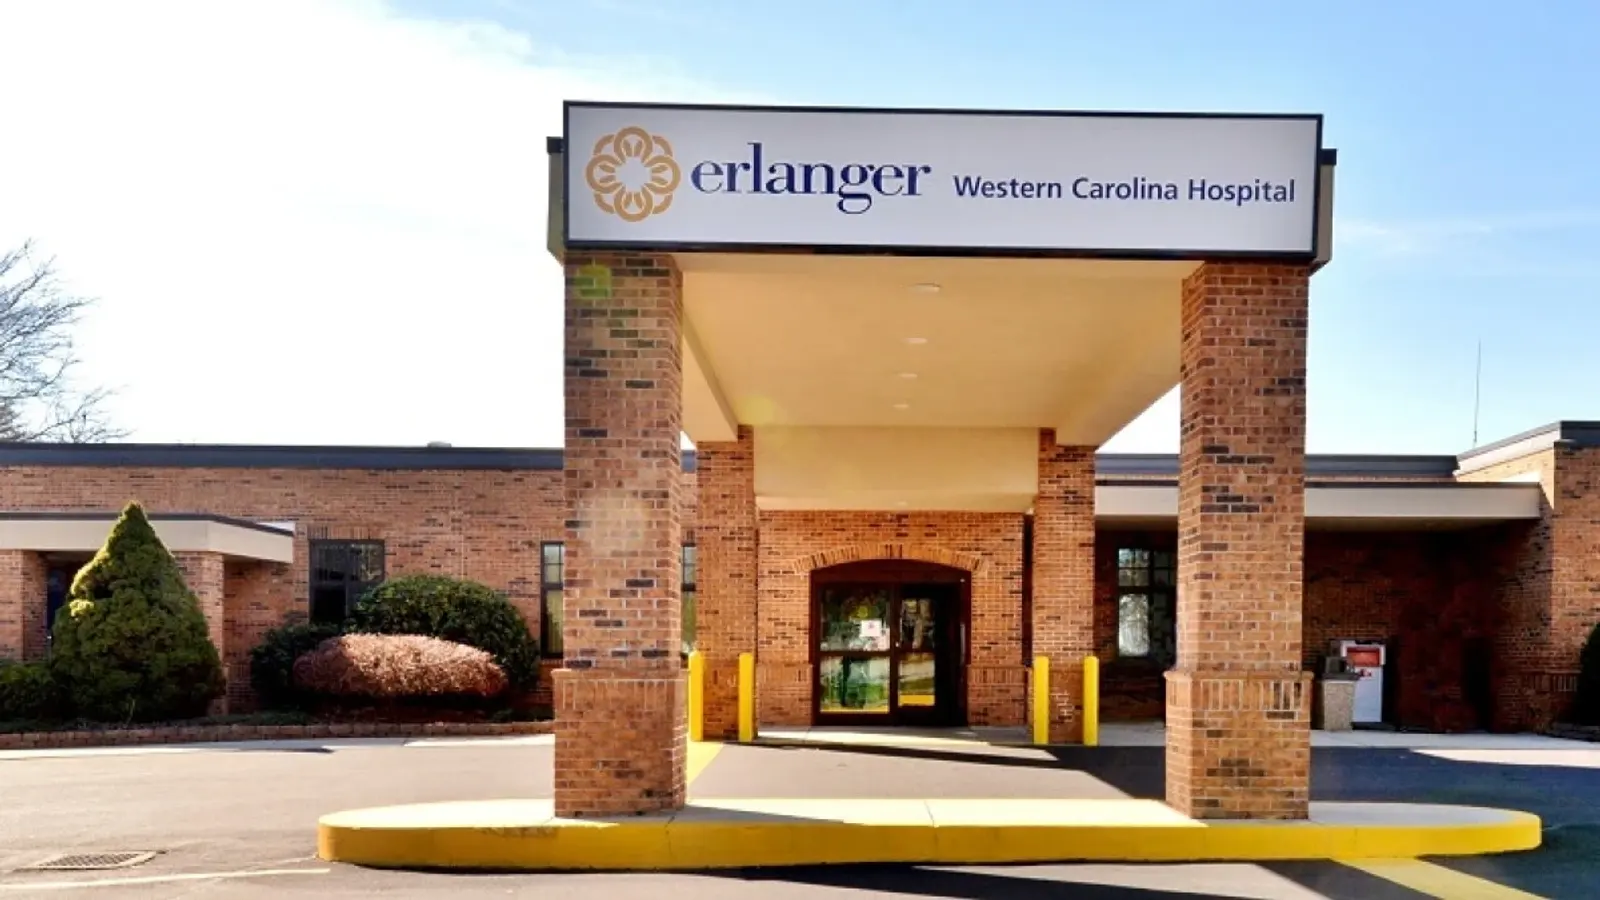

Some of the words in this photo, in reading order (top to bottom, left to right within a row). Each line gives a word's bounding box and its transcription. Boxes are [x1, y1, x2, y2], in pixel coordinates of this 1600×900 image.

[691, 142, 932, 214] erlanger
[953, 175, 1062, 199] Western
[1072, 176, 1178, 200] Carolina
[1189, 178, 1295, 206] Hospital
